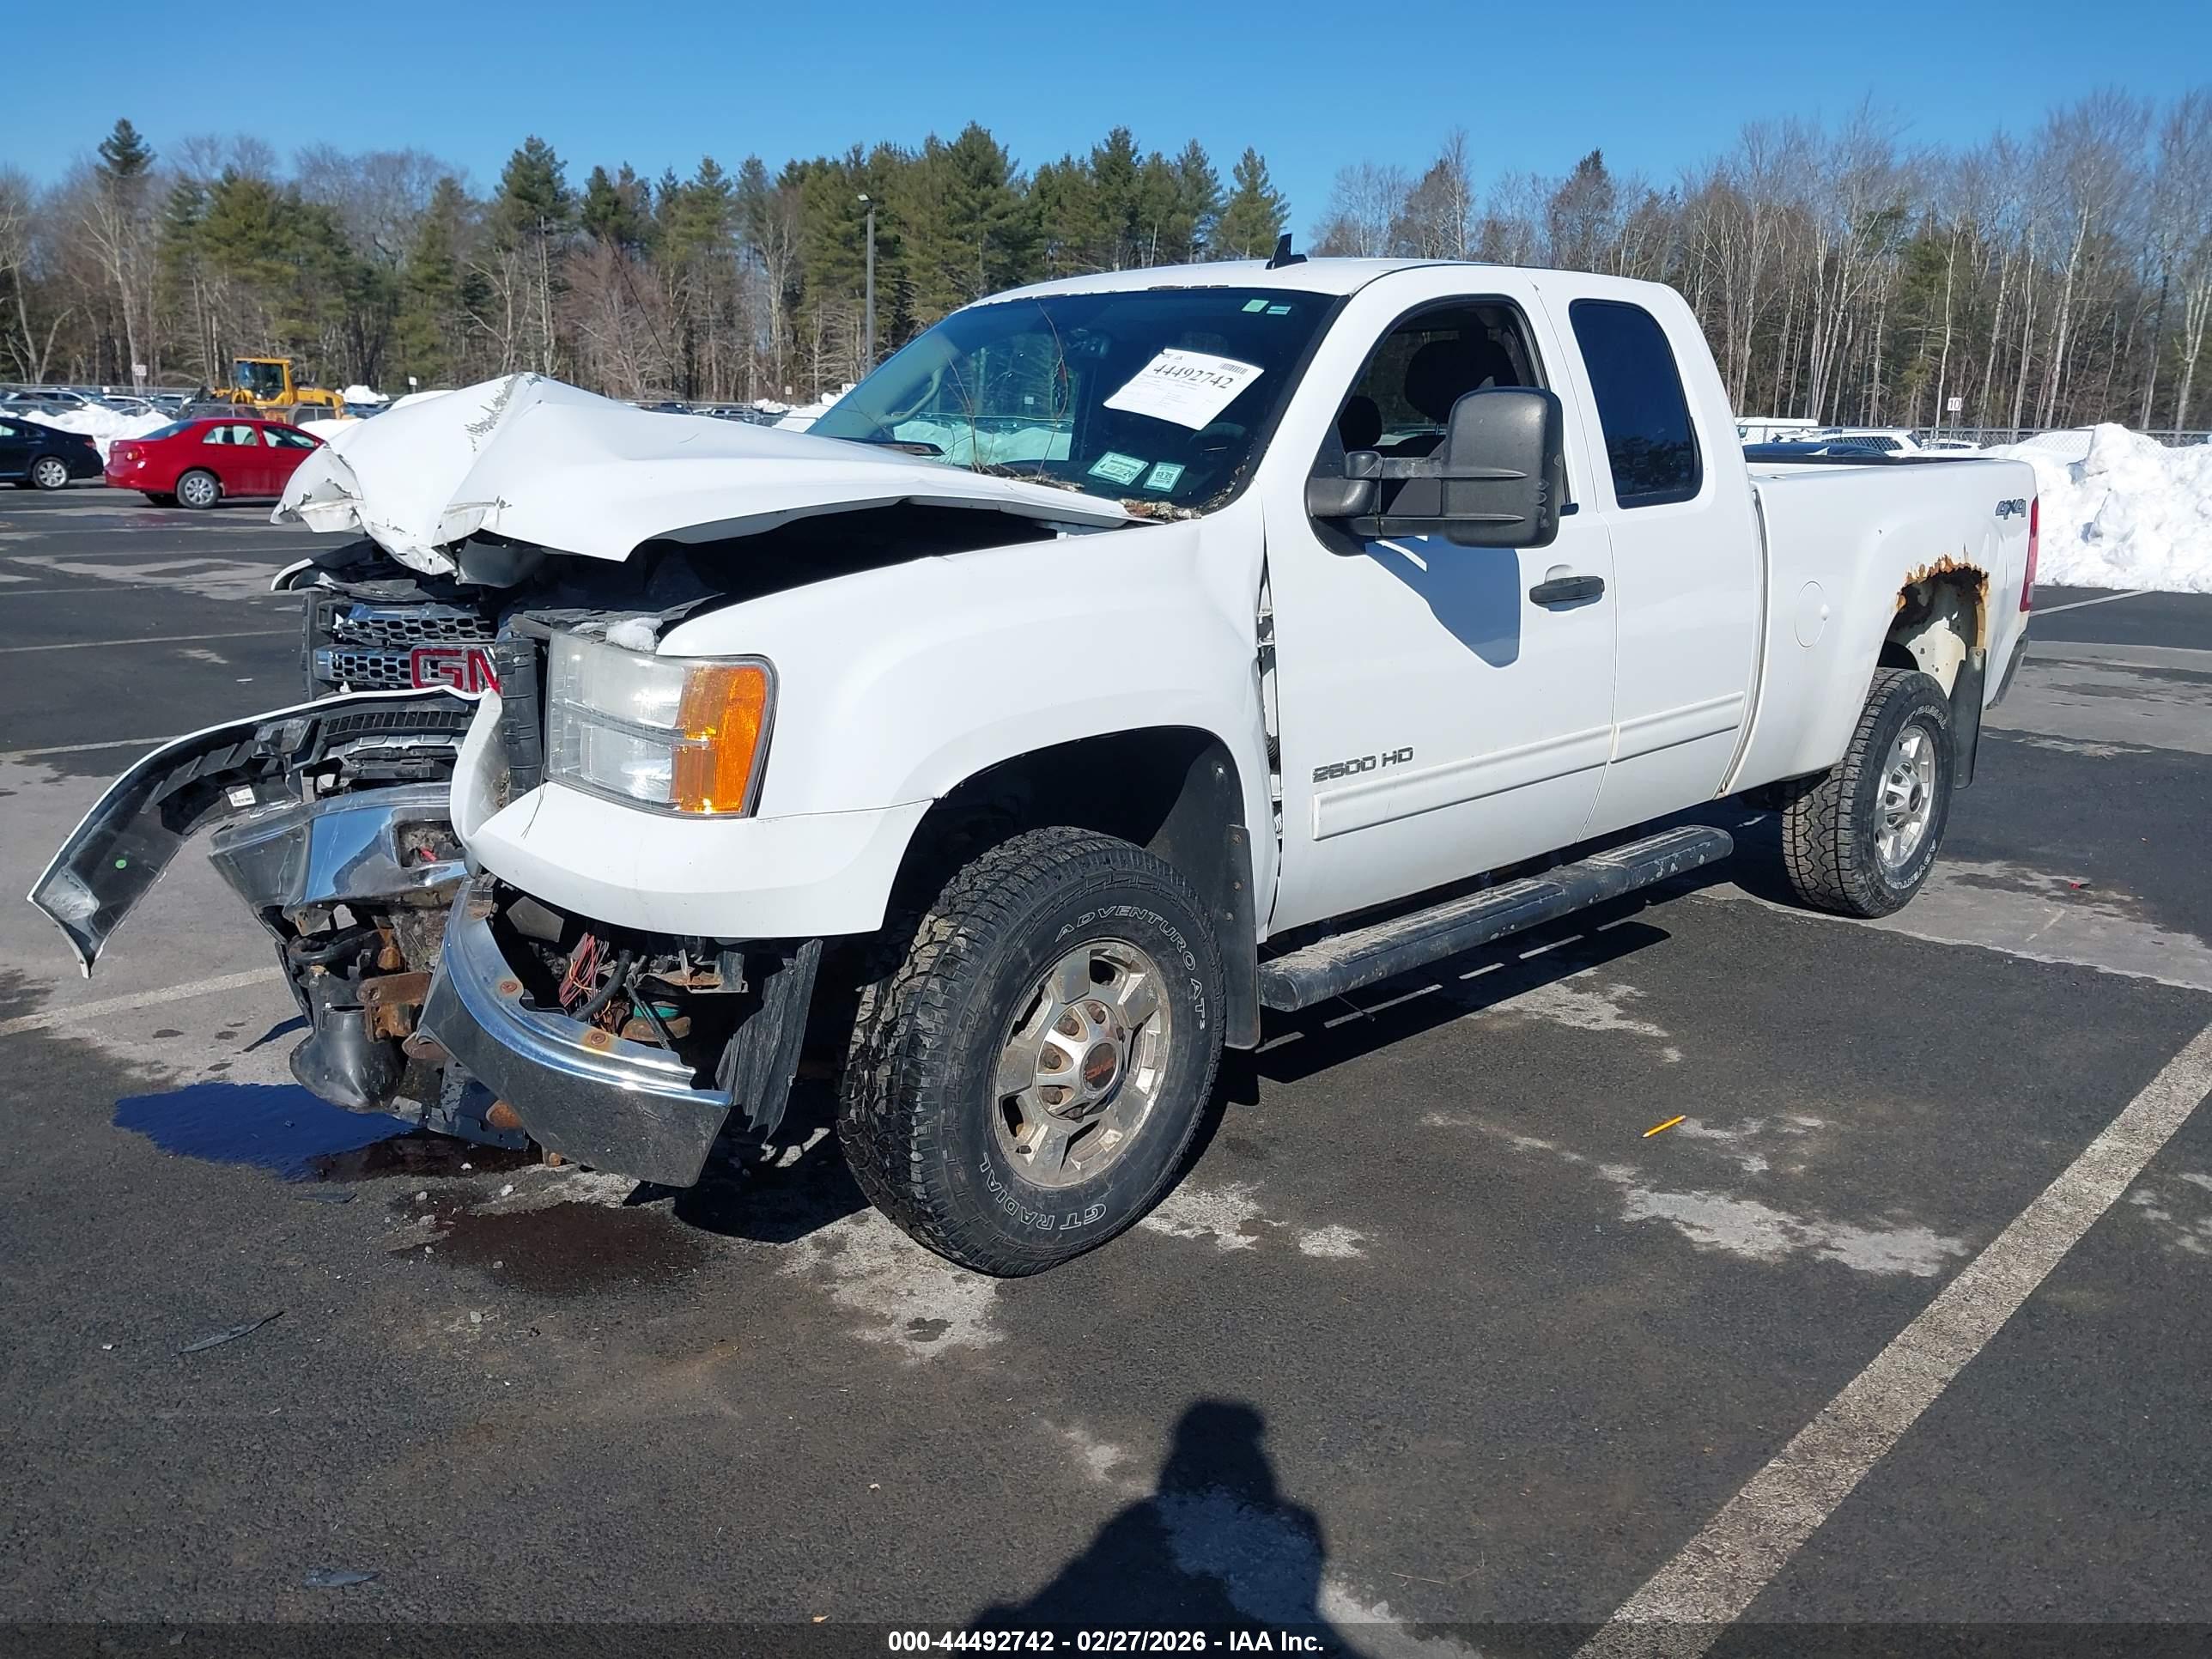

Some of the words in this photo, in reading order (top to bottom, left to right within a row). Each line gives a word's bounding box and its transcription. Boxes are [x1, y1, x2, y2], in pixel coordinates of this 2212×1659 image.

[1152, 363, 1235, 390] 44492742
[1948, 398, 1961, 410] 10
[1312, 756, 1376, 783] 2500
[1382, 746, 1413, 768] HD
[1054, 905, 1196, 971] ADVENTURO
[979, 1152, 1055, 1231] RADIAL
[1060, 1202, 1108, 1231] GT
